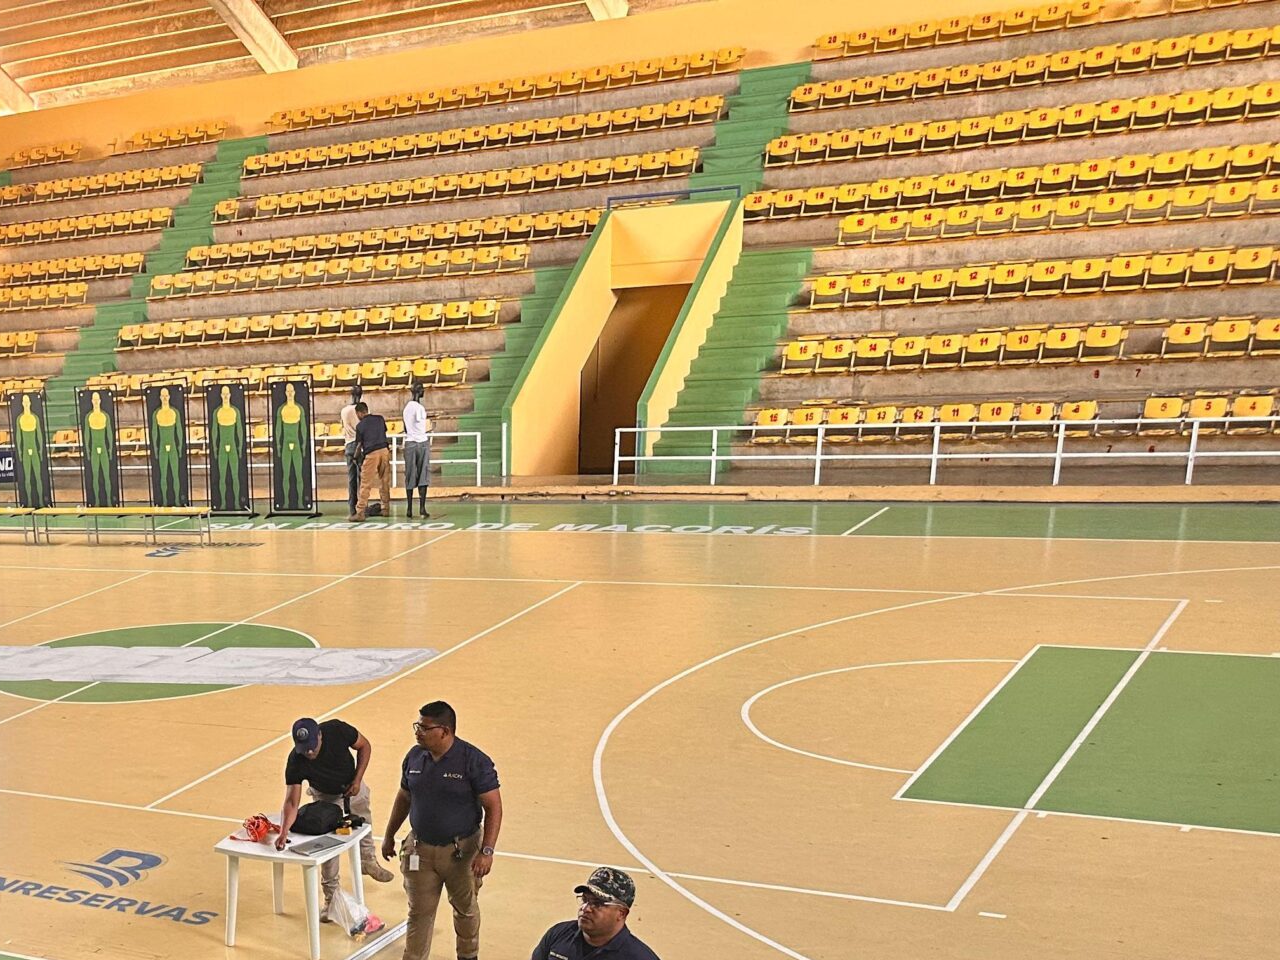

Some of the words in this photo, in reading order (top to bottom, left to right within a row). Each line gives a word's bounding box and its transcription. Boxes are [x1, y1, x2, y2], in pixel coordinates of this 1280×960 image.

[919, 24, 928, 32] 17
[1247, 32, 1254, 41] 7
[1132, 46, 1141, 55] 10
[1171, 42, 1177, 50] 9
[1061, 56, 1069, 64] 12
[1096, 51, 1103, 60] 11
[960, 69, 968, 77] 15
[992, 65, 1001, 73] 14
[1228, 91, 1234, 100] 7
[1074, 109, 1082, 118] 11
[1111, 105, 1119, 114] 10
[1039, 113, 1047, 122] 12
[937, 125, 946, 133] 15
[970, 121, 979, 130] 14
[872, 131, 881, 140] 17
[1208, 153, 1215, 162] 7
[1088, 164, 1098, 172] 10
[1130, 160, 1136, 168] 9
[1016, 171, 1025, 180] 12
[912, 181, 922, 190] 15
[1272, 184, 1279, 193] 5
[1189, 190, 1195, 199] 7
[753, 196, 762, 204] 20
[1069, 200, 1080, 209] 10
[1109, 197, 1114, 205] 9
[995, 207, 1003, 215] 12
[1032, 204, 1041, 212] 11
[959, 210, 968, 219] 13
[890, 216, 898, 224] 15
[1208, 256, 1214, 265] 6
[1252, 252, 1259, 262] 5
[1166, 257, 1173, 267] 7
[1045, 266, 1055, 275] 10
[1085, 263, 1091, 272] 9
[969, 271, 978, 280] 12
[1007, 269, 1014, 277] 11
[862, 278, 871, 287] 15
[933, 274, 942, 283] 13
[829, 280, 837, 289] 16
[1229, 324, 1236, 333] 5
[942, 339, 951, 348] 12
[980, 337, 988, 346] 11
[1018, 335, 1029, 344] 10
[800, 345, 808, 354] 16
[834, 344, 843, 353] 15
[905, 341, 914, 349] 13
[1094, 370, 1099, 378] 8
[1136, 369, 1141, 377] 7
[1036, 406, 1041, 414] 9
[1205, 401, 1212, 411] 5
[1249, 402, 1256, 411] 4
[877, 411, 886, 420] 13
[952, 408, 959, 417] 11
[991, 407, 1002, 416] 10
[805, 412, 814, 421] 15
[469, 523, 539, 531] DE
[548, 523, 814, 535] MACORÍS
